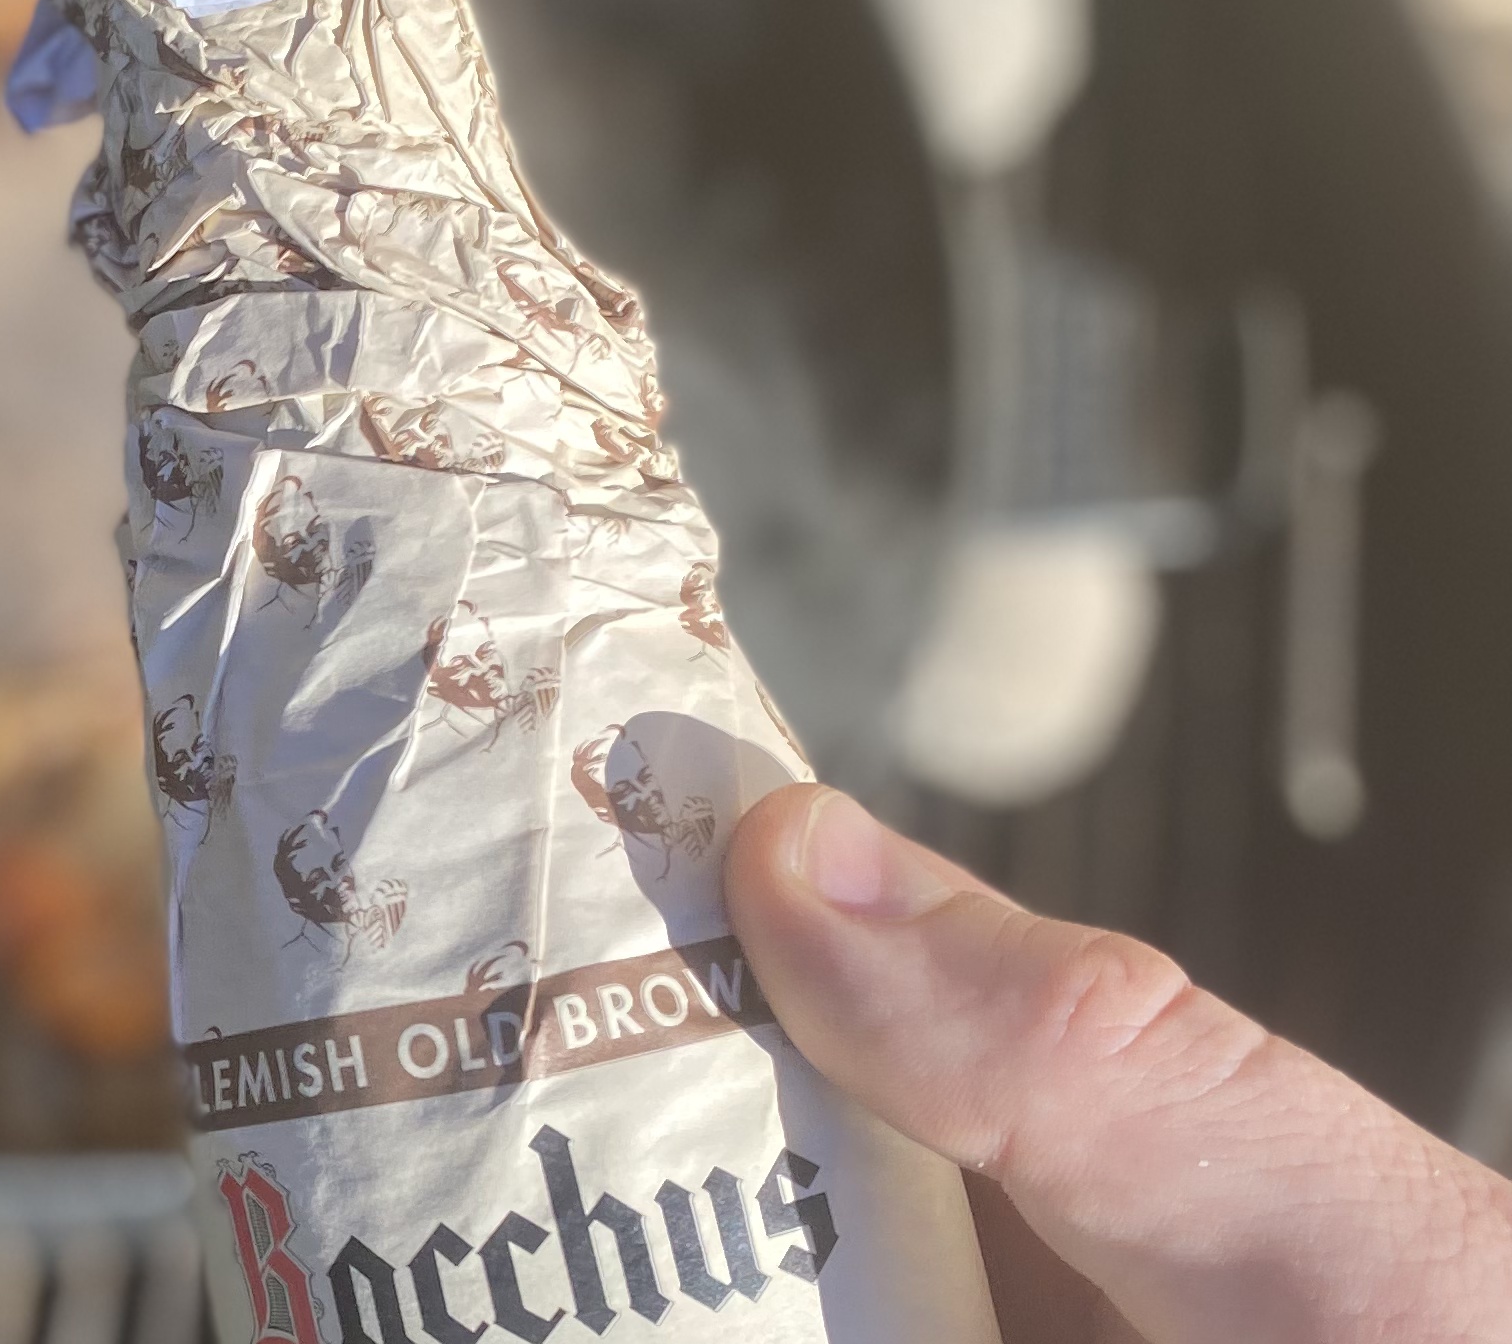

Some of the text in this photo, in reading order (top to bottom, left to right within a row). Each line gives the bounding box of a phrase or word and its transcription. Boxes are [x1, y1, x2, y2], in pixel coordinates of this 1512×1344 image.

[192, 957, 742, 1113] LEMISH OLD BROW
